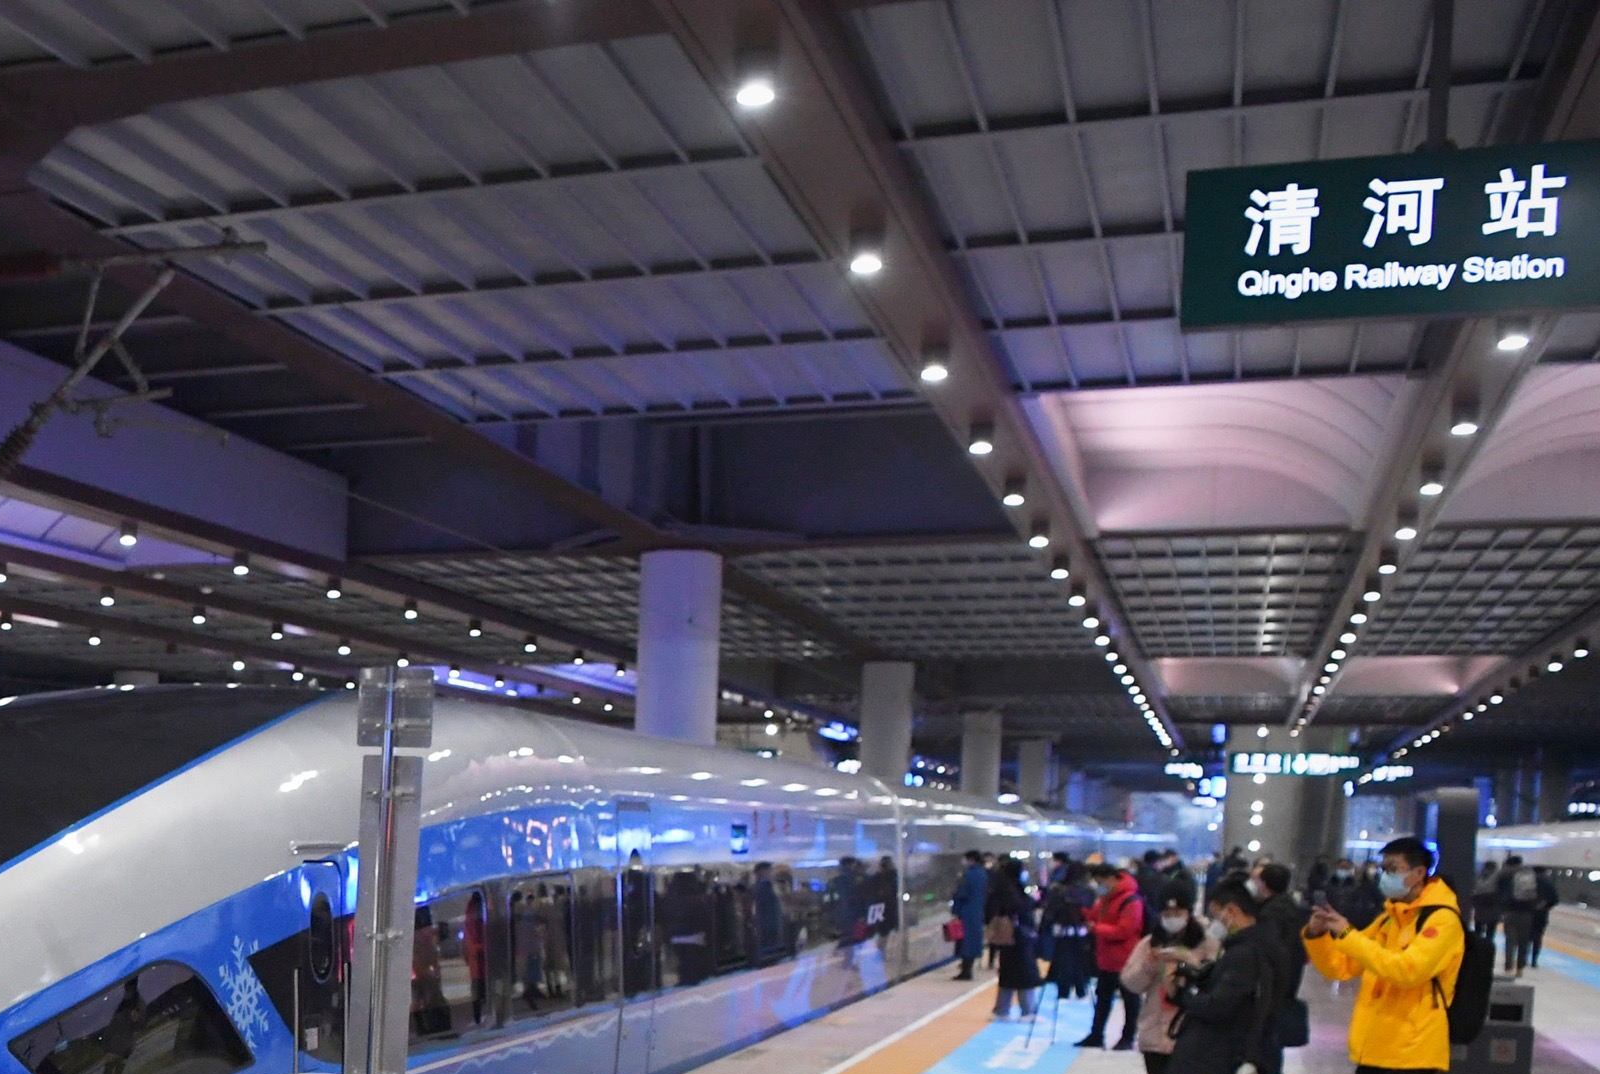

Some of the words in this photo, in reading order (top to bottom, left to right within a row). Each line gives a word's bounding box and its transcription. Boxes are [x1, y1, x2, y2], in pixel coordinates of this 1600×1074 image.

[1244, 164, 1567, 257] 清河站
[1238, 267, 1338, 299] Qinghe
[1344, 261, 1457, 291] Railway
[1462, 254, 1565, 283] Station
